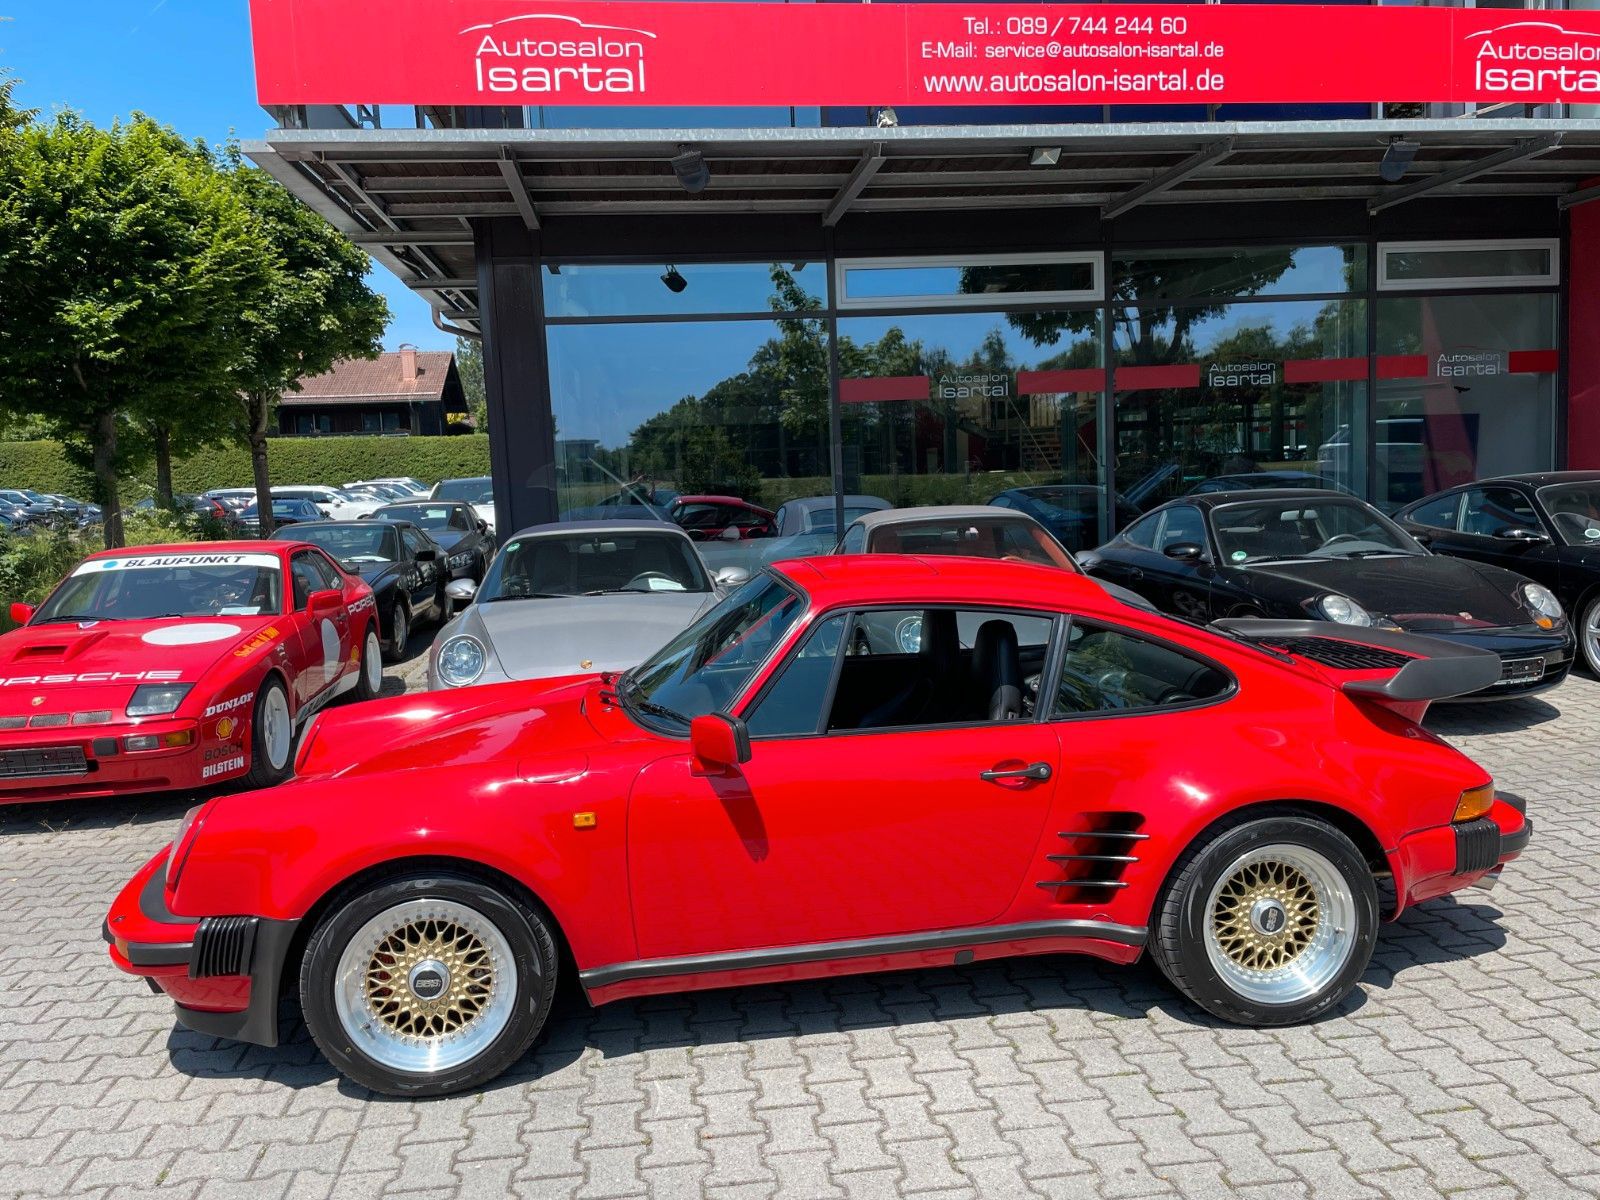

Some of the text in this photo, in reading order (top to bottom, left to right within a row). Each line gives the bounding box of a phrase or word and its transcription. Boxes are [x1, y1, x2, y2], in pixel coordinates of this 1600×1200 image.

[963, 17, 1001, 35] Tel.:
[1006, 17, 1048, 35] 089
[1068, 17, 1108, 35] 744
[1115, 17, 1154, 35] 244
[1160, 17, 1187, 35] 60
[476, 35, 643, 57] Autosalon
[921, 41, 1224, 58] E-Mail: service@autosalon-isartal.de
[1477, 40, 1600, 61] Autosalo
[475, 58, 645, 92] Isartal
[924, 68, 1224, 93] www.autosalon-isartal.de
[1438, 352, 1500, 363] Autosalon
[1209, 362, 1276, 372] Autosalon
[1437, 361, 1500, 377] Isartal
[940, 373, 1009, 383] Autosalon
[1209, 370, 1276, 387] Isartal
[939, 382, 1009, 398] Isartal
[123, 555, 247, 568] BLAUPUNKT
[0, 670, 183, 687] RSCHE
[205, 691, 254, 718] DUNLOP
[203, 741, 243, 760] BOSCH
[202, 755, 245, 779] BILSTEIN
